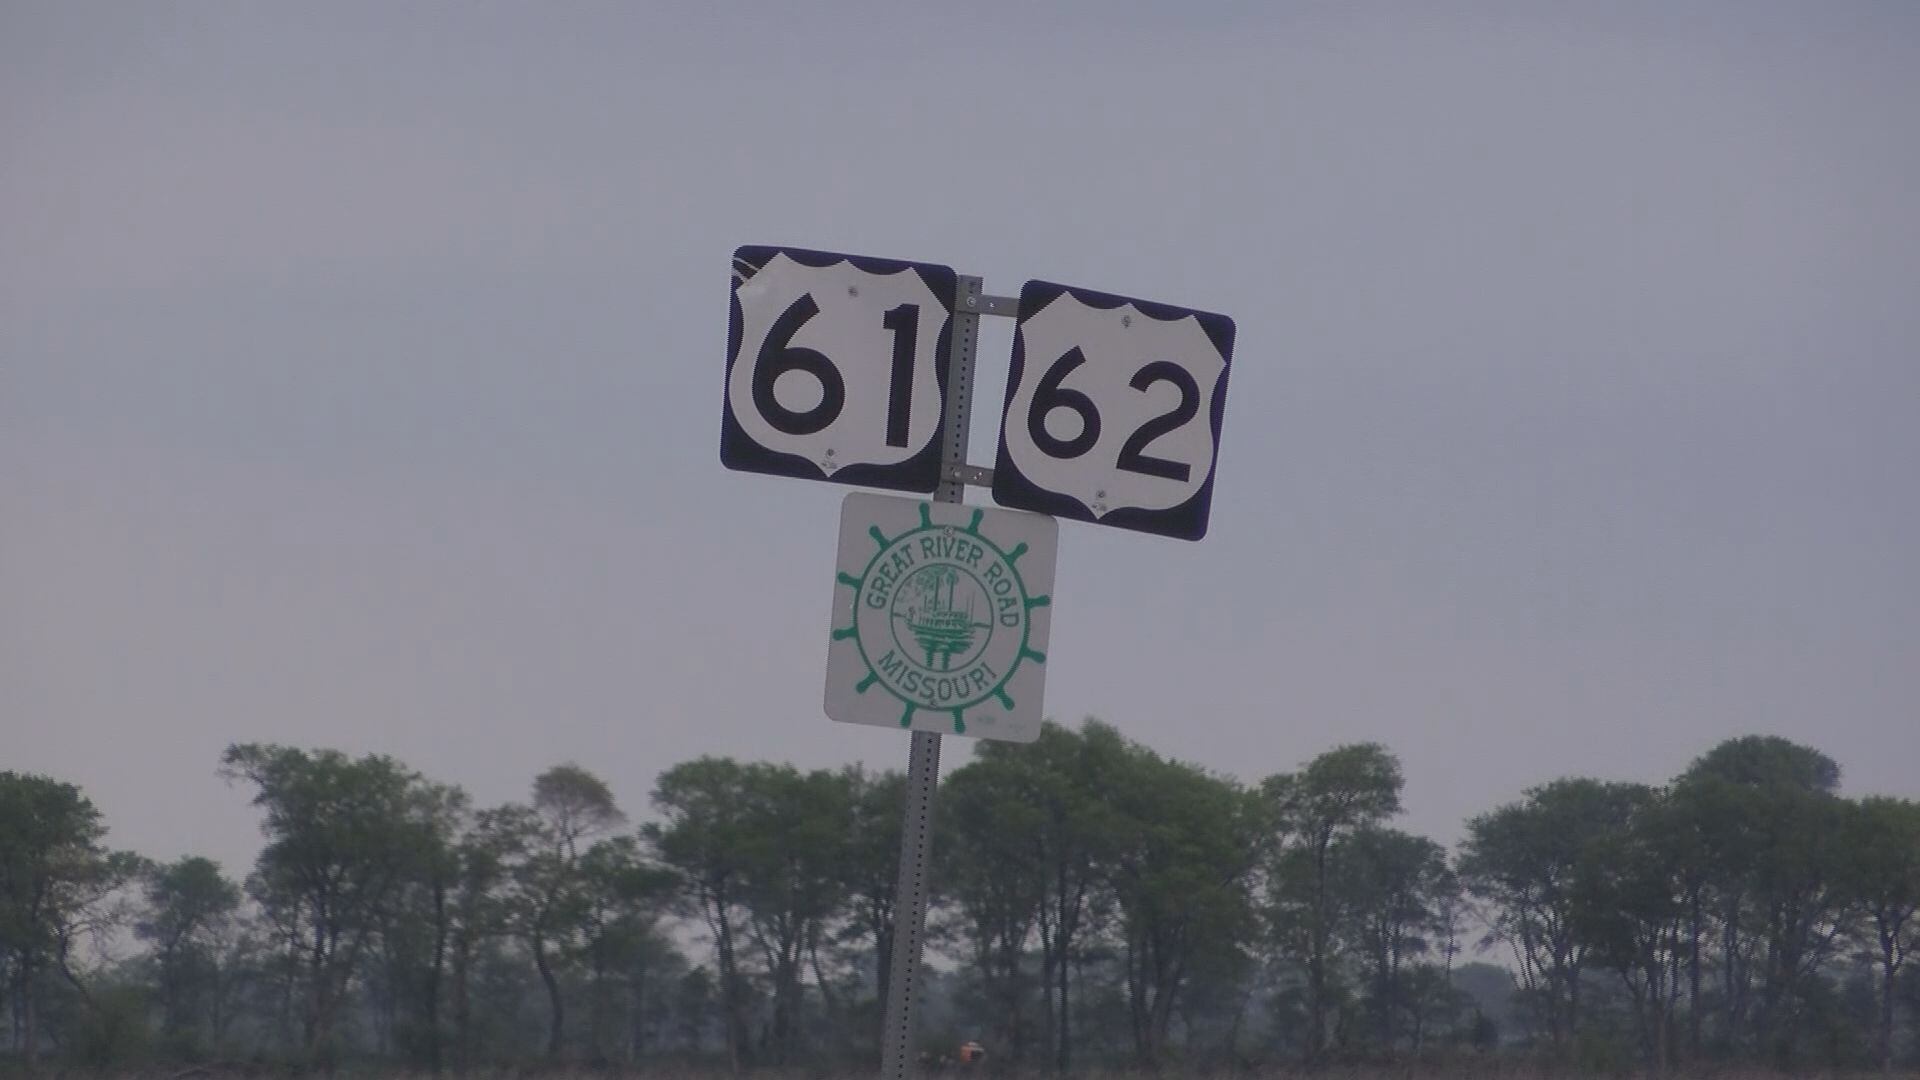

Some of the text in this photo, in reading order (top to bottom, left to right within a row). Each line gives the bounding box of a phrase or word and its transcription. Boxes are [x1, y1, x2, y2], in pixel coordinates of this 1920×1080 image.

[752, 292, 920, 449] 61
[1027, 344, 1201, 483] 62
[866, 535, 1020, 628] GREAT RIVER ROAD
[877, 649, 998, 701] MISSOURI
